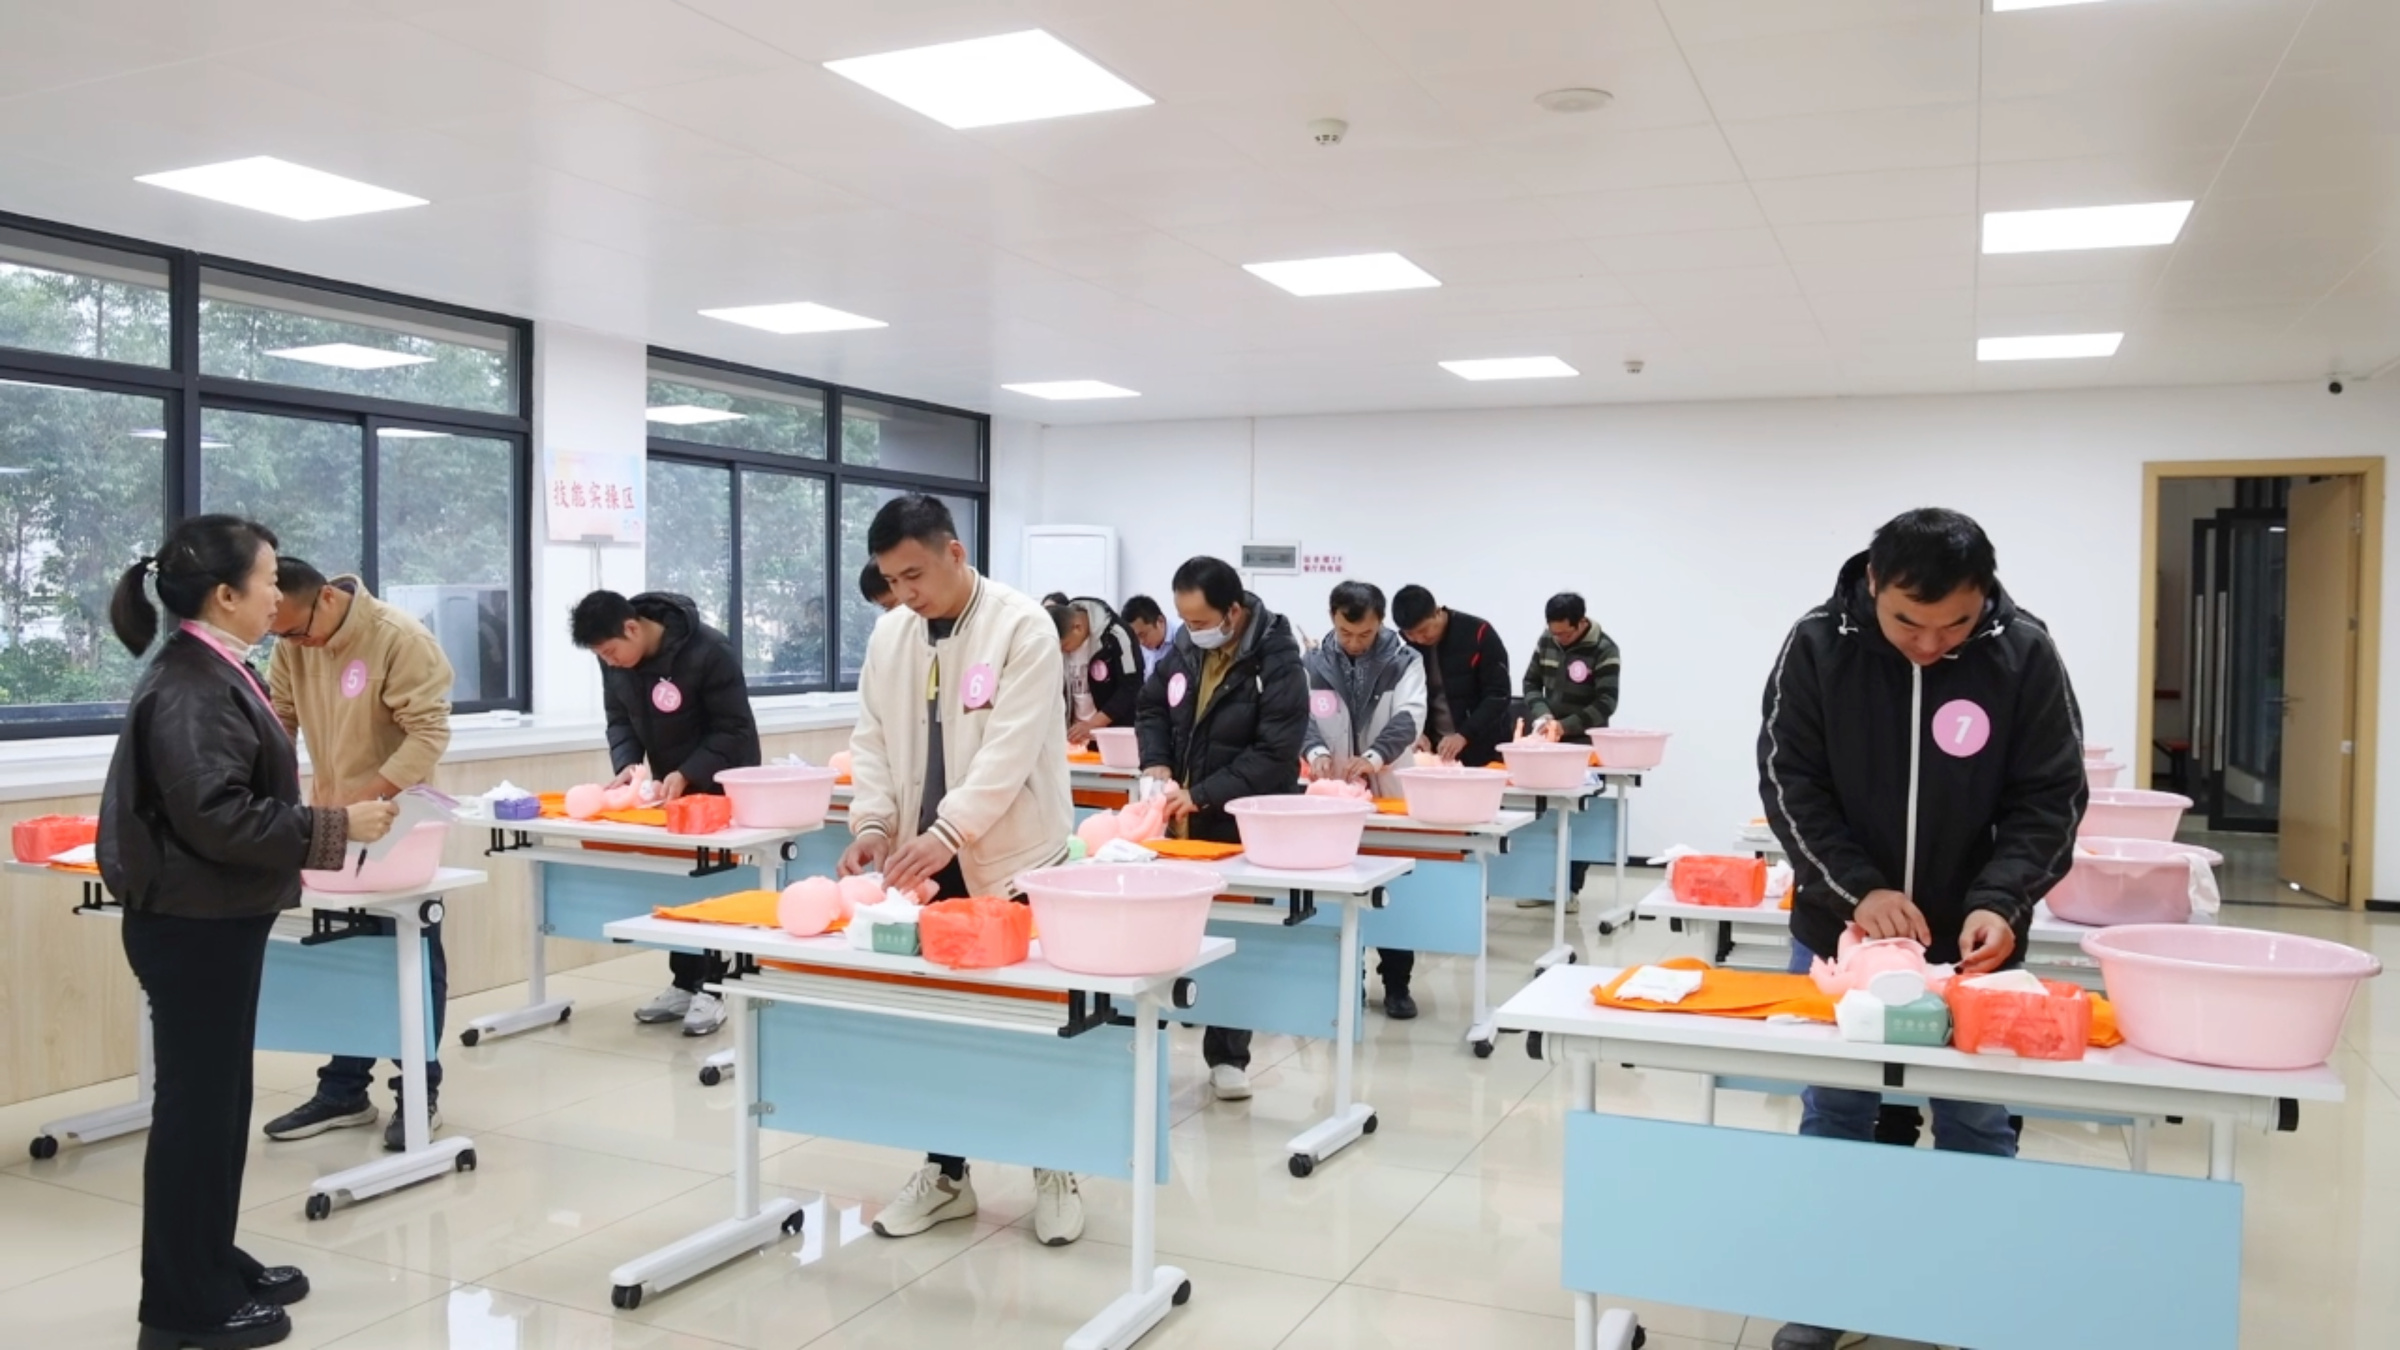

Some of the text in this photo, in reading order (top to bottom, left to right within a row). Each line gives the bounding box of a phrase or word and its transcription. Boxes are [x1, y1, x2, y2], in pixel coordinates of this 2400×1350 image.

[553, 480, 635, 510] 技能实操区
[347, 668, 360, 689] 5
[969, 673, 984, 698] 6
[657, 687, 678, 707] 13
[1318, 697, 1330, 712] 8
[1955, 715, 1973, 745] 1
